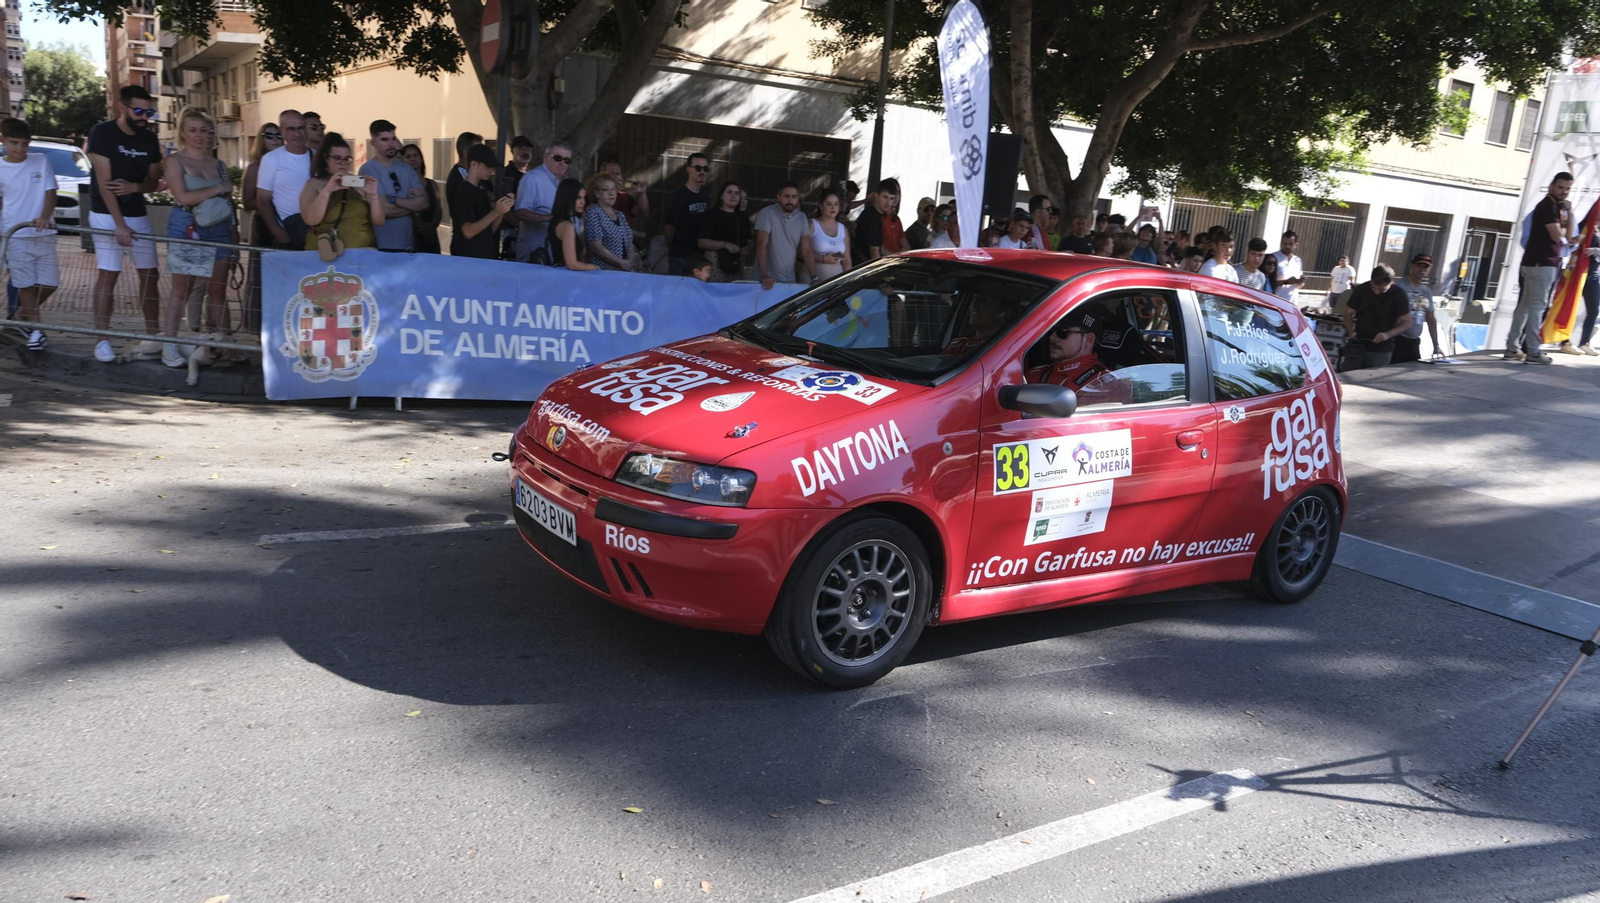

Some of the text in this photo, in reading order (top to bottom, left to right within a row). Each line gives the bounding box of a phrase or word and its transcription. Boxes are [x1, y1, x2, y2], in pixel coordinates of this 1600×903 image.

[401, 294, 644, 335] AYUNTAMIENTO
[1082, 314, 1095, 328] FIAT
[400, 328, 591, 363] DE ALMERÍA
[738, 372, 827, 402] REFORMAS
[854, 385, 882, 398] 33
[537, 399, 611, 442] garfusa.com
[1271, 388, 1316, 465] gar
[791, 419, 909, 497] DAYTONA
[997, 444, 1029, 490] 33
[1088, 456, 1130, 475] ALMERÍA
[1095, 447, 1130, 460] COSTA DE
[1260, 428, 1330, 500] fusa
[1033, 468, 1067, 478] CUPRA
[605, 524, 650, 554] Ríos
[1034, 546, 1116, 573] Garfusa
[1119, 545, 1145, 562] no
[1148, 540, 1185, 564] hay
[1186, 532, 1255, 557] excusa!!
